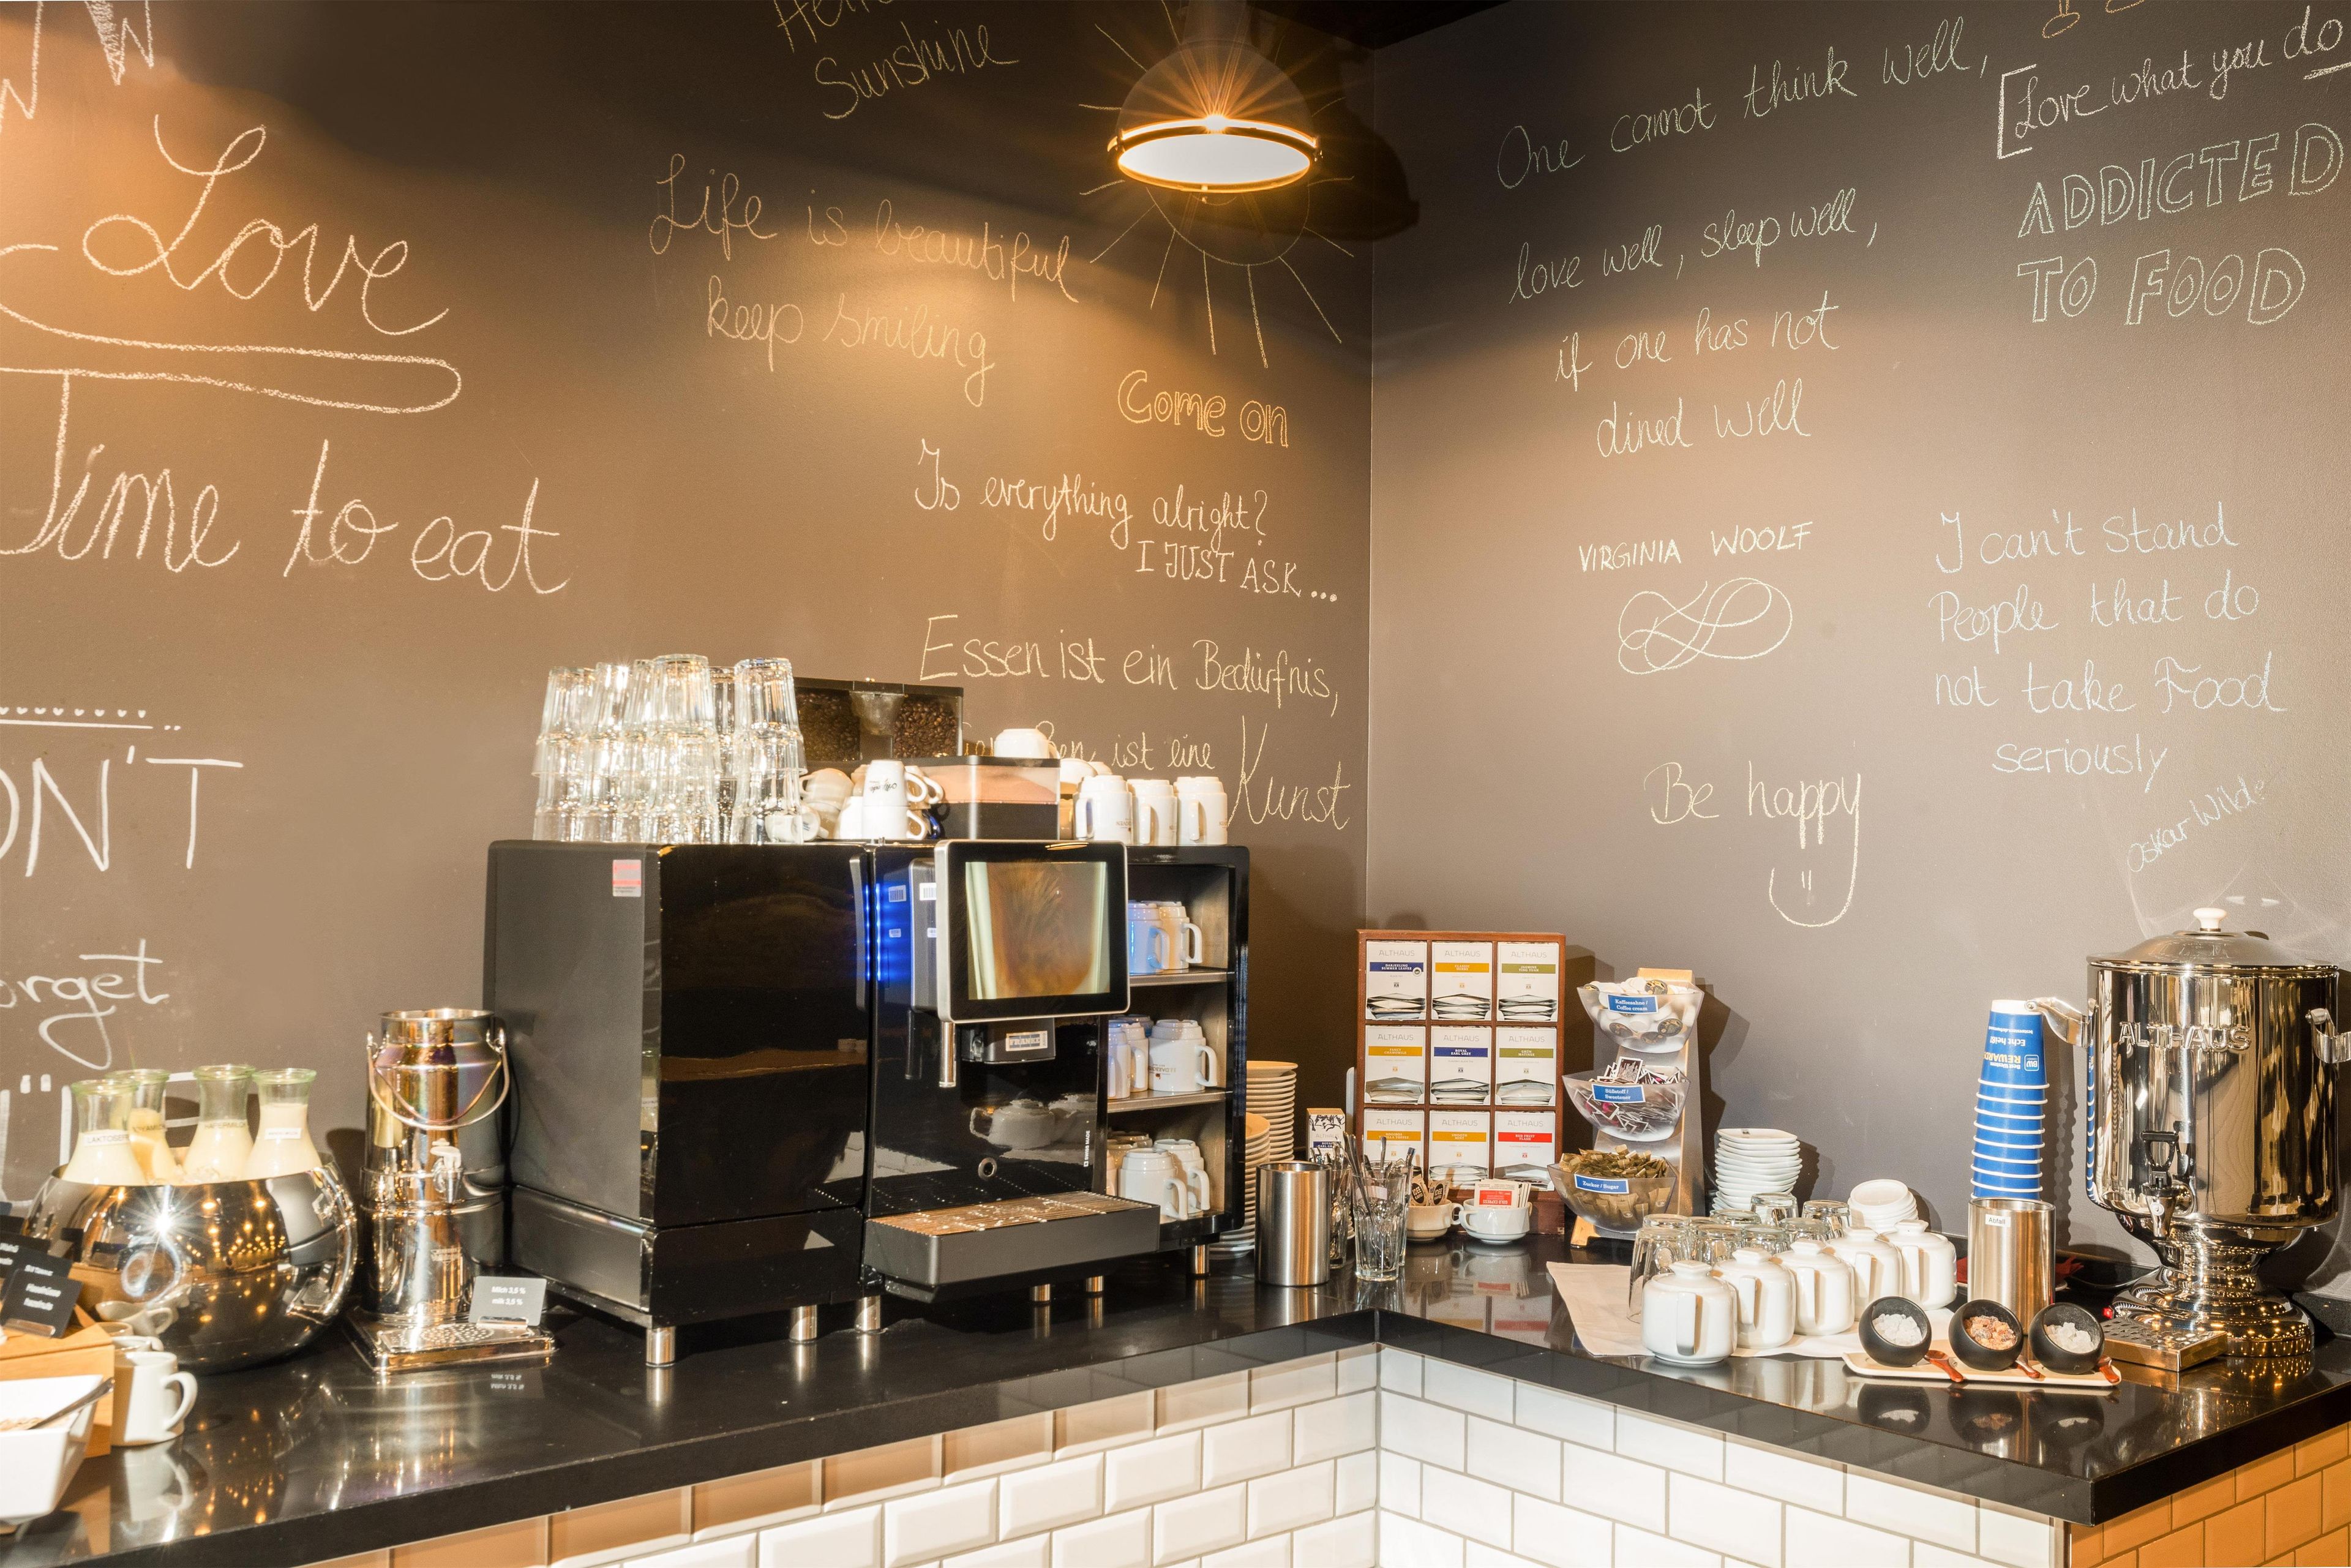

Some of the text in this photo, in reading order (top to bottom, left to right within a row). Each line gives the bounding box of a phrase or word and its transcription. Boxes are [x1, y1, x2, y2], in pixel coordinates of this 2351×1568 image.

[816, 21, 1019, 118] Sunshine
[1498, 126, 1585, 189] One
[1744, 46, 1857, 118] think
[1883, 17, 1987, 84] well,
[2015, 6, 2342, 138] Love what you do
[83, 114, 449, 335] Love
[650, 154, 1079, 302] Life is beautiful
[2018, 123, 2344, 238] ADDICTED
[1509, 188, 1877, 304] love well, sleep well,
[2018, 247, 2305, 324] TO FOOD
[708, 276, 995, 407] keep smiling
[1556, 291, 1839, 392] if one has not
[1118, 370, 1289, 448] Come on
[1597, 378, 1811, 457] dined well
[285, 439, 398, 577] to
[411, 478, 570, 593] eat
[915, 438, 1268, 554] Is everything alright?
[1936, 512, 1963, 573] I
[1981, 508, 2085, 565] can't
[1135, 541, 1155, 572] I
[1164, 541, 1234, 583] JUST
[1580, 522, 1813, 572] VIRGINIA WOOLF
[1928, 569, 2259, 655] People that do
[920, 614, 1339, 717] Essen ist ein Bedürfnis,
[1936, 651, 2287, 713] not take Food
[1111, 732, 1154, 770] ist
[1168, 733, 1215, 770] eine
[1226, 715, 1350, 830] Kunst
[1992, 733, 2167, 793] seriously
[1644, 760, 1861, 882] Be happy
[1984, 1051, 2021, 1064] REWARD
[2119, 1021, 2251, 1052] ALTHAUS
[1412, 1187, 1422, 1196] IDEE
